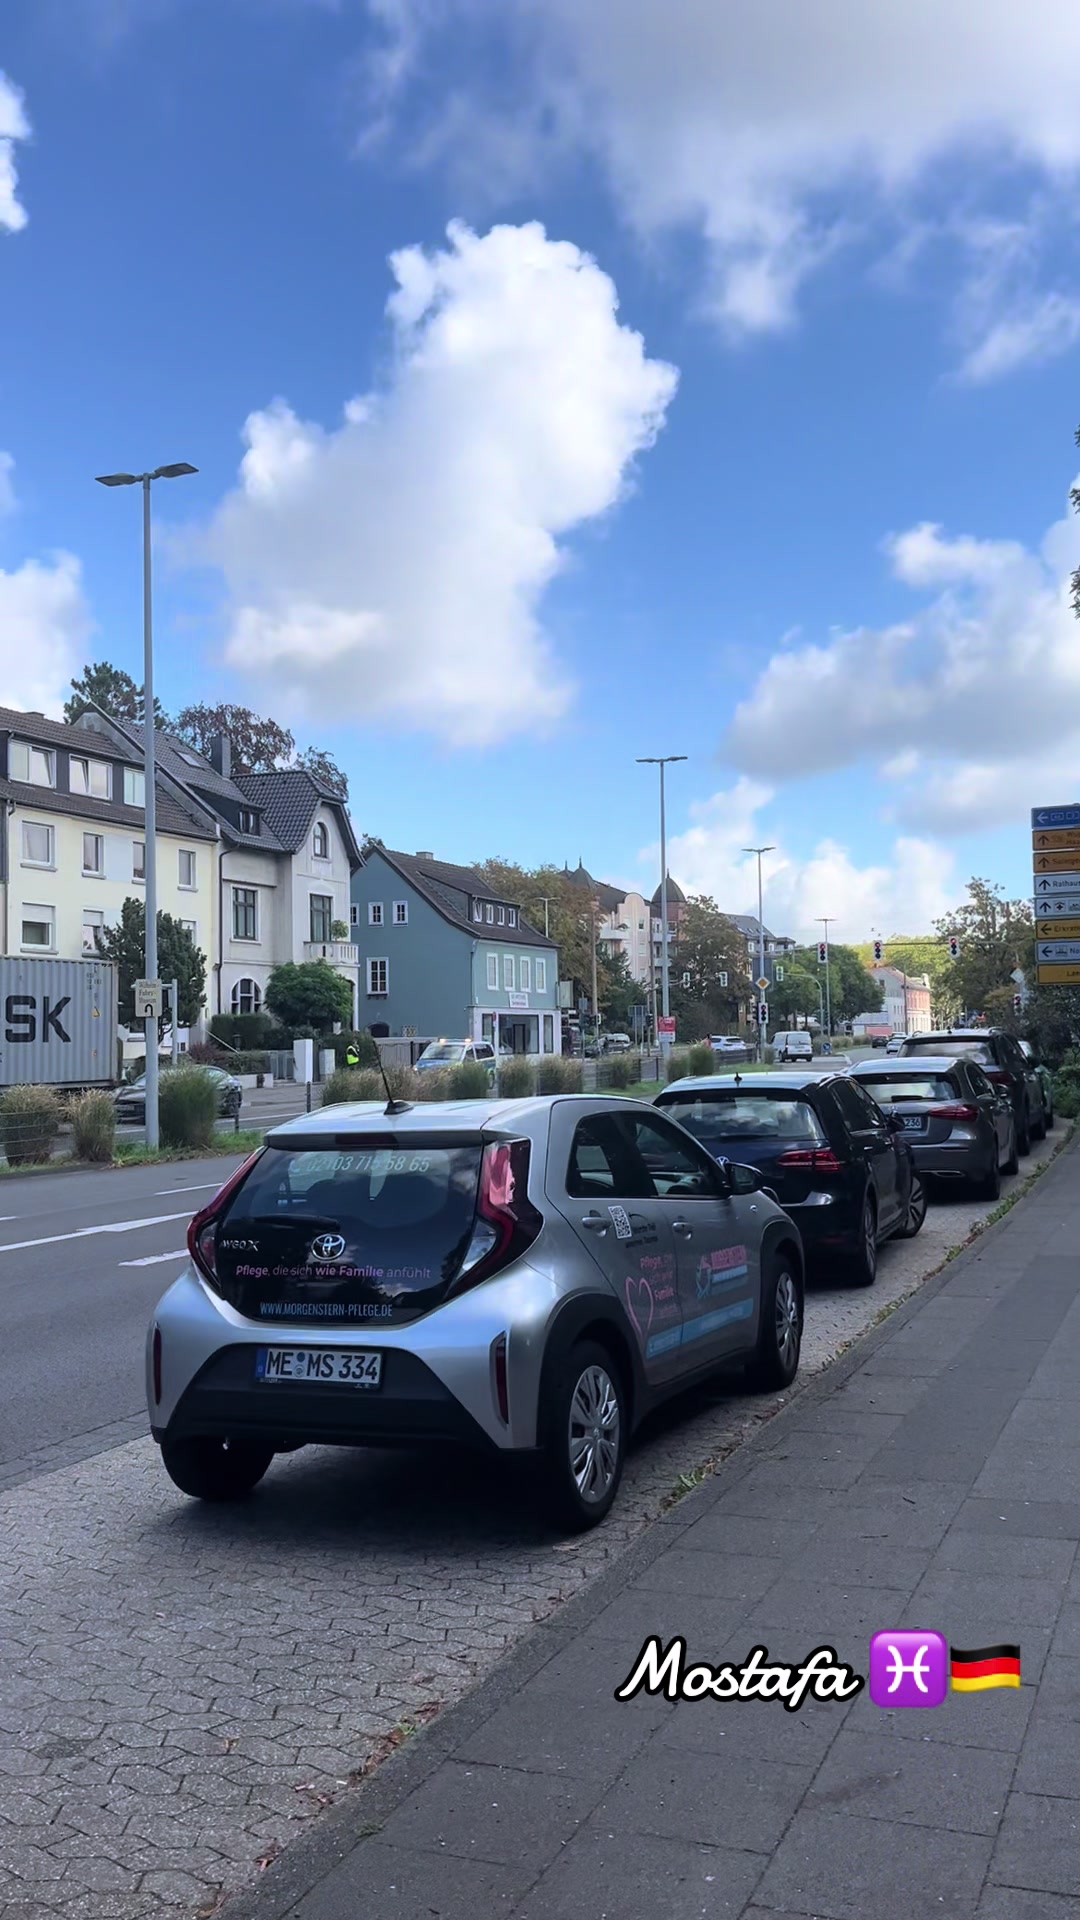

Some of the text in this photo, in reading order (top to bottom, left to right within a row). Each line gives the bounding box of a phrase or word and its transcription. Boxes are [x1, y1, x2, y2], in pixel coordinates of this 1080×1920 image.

[408, 1156, 431, 1173] 65
[235, 1264, 431, 1279] Pflege, die sich wie Familie anfühlt
[260, 1301, 393, 1317] WWW.MORGENSTERN-PFLEGE.DE
[266, 1351, 378, 1380] ME MS 334
